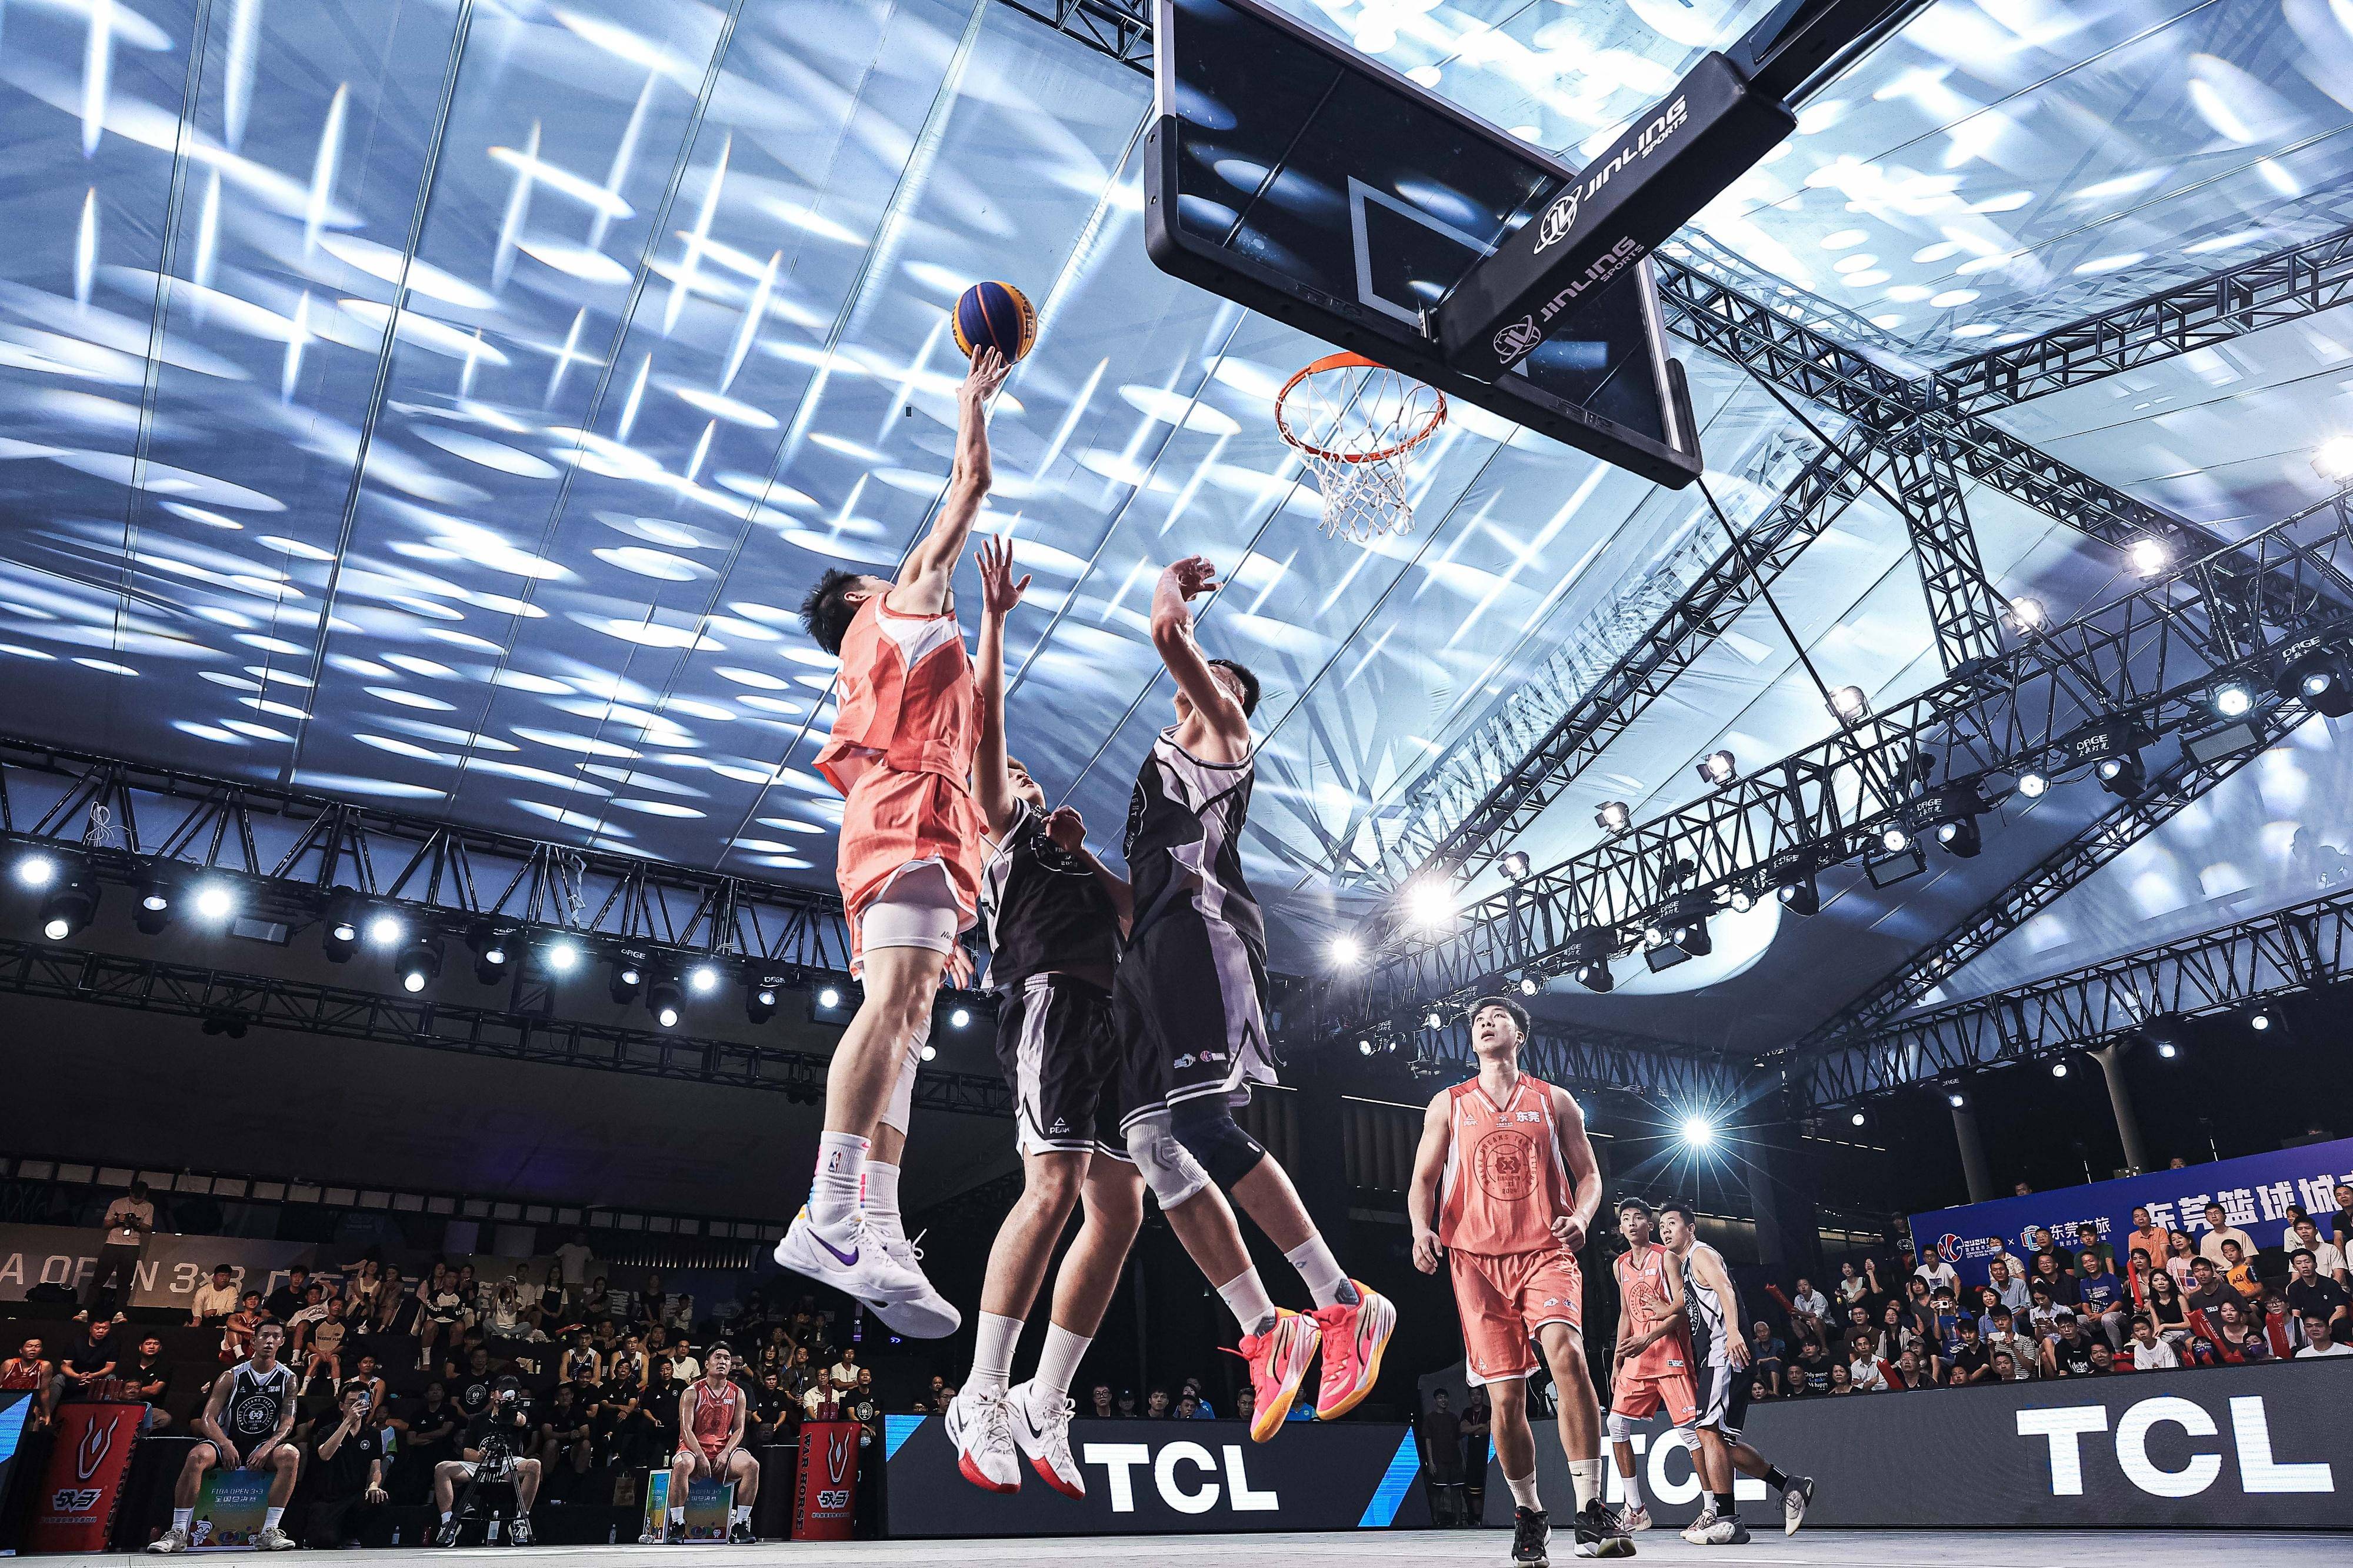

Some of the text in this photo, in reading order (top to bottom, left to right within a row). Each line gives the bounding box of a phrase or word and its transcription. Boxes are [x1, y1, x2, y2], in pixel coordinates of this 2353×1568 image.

[1641, 111, 1688, 159] SPORTS
[1600, 242, 1644, 282] SPORTS
[2282, 636, 2321, 658] DAGE
[2077, 734, 2108, 750] DAGE
[1917, 798, 1942, 812] DAGE
[1661, 900, 1679, 913] DAGE
[1049, 1126, 1070, 1134] PEAK
[1515, 1110, 1540, 1123] 东莞
[1481, 1134, 1509, 1155] DREAMS
[2144, 1170, 2353, 1235] 东莞篮球城
[40, 1255, 159, 1292] OPN
[2015, 1394, 2335, 1497] TCL
[795, 1432, 812, 1531] WAR HORSE
[1084, 1441, 1279, 1514] TCL
